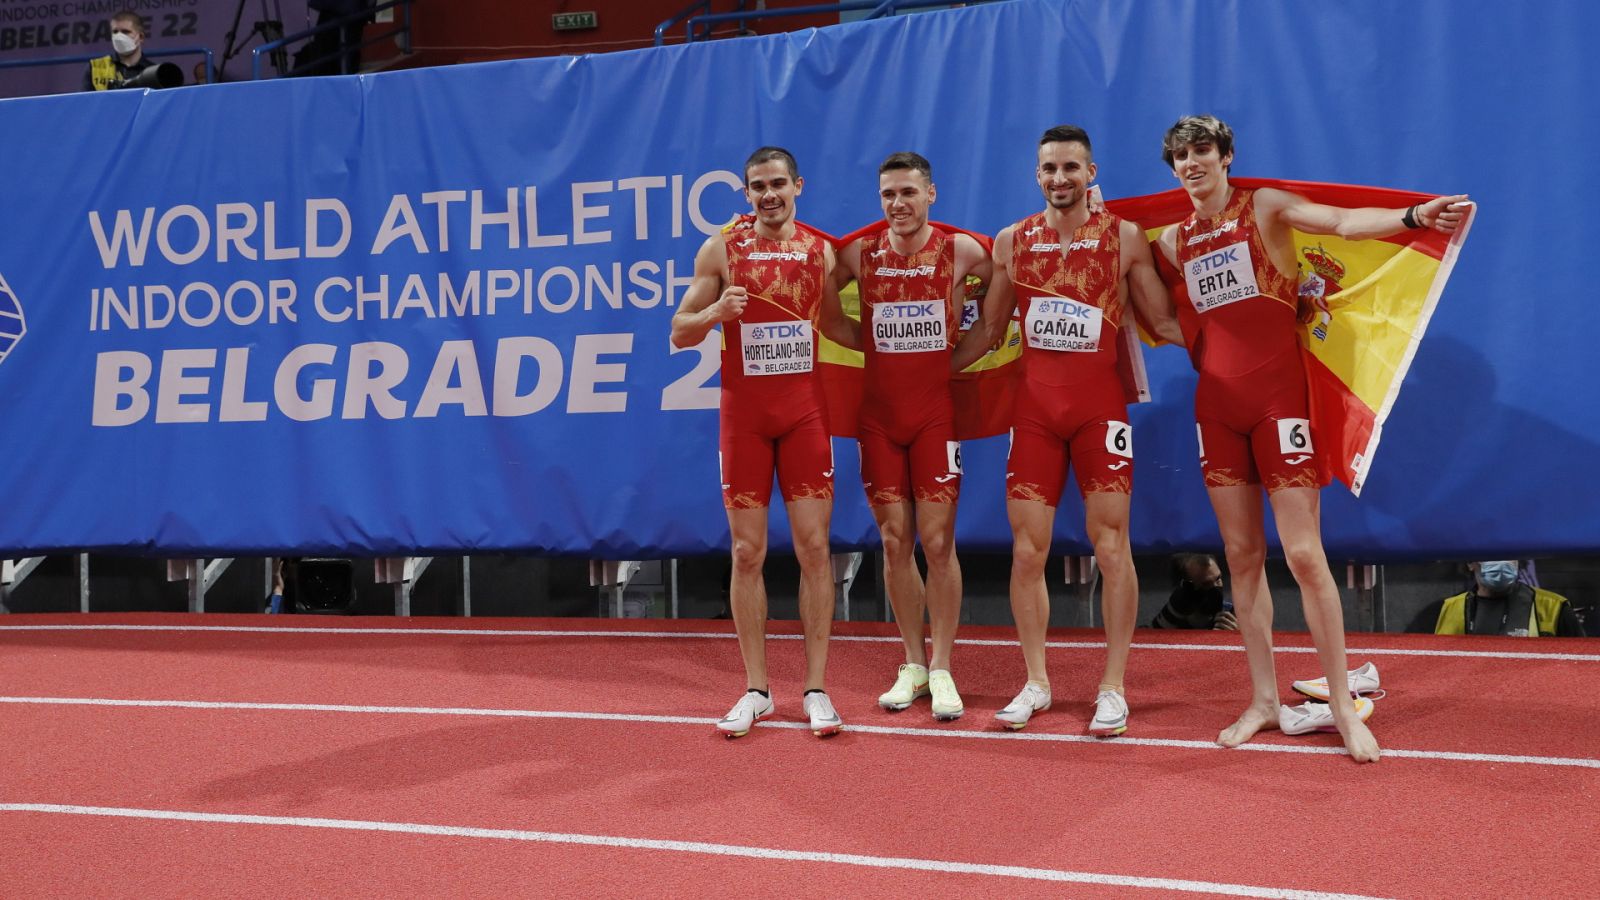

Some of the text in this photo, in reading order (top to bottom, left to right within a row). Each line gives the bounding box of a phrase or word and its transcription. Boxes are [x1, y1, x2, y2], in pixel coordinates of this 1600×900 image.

[556, 14, 591, 27] EXIT
[0, 12, 198, 51] BELGRAE 22
[88, 198, 352, 269] WORLD
[1187, 218, 1239, 246] ESPAÑA
[1030, 239, 1100, 252] ESPAÑA
[747, 251, 808, 261] ESPAÑA
[1200, 248, 1239, 271] TDK
[875, 266, 936, 277] ESPAÑA
[1198, 270, 1238, 296] ERTA
[90, 278, 297, 331] INDOOR
[1206, 285, 1256, 307] BELGRADE 22
[893, 304, 935, 318] TDK
[1051, 301, 1091, 319] TDK
[764, 324, 804, 338] TDK
[876, 320, 942, 338] GUIJARRO
[1033, 318, 1089, 338] CAÑAL
[744, 340, 811, 361] HORTELANO-ROIG
[894, 339, 944, 351] BELGRADE 22
[1042, 338, 1095, 350] BELGRADE 22
[765, 361, 811, 373] BELGRADE 22
[91, 332, 634, 427] BELGRADE
[1114, 427, 1126, 451] 6
[1289, 423, 1306, 448] 6
